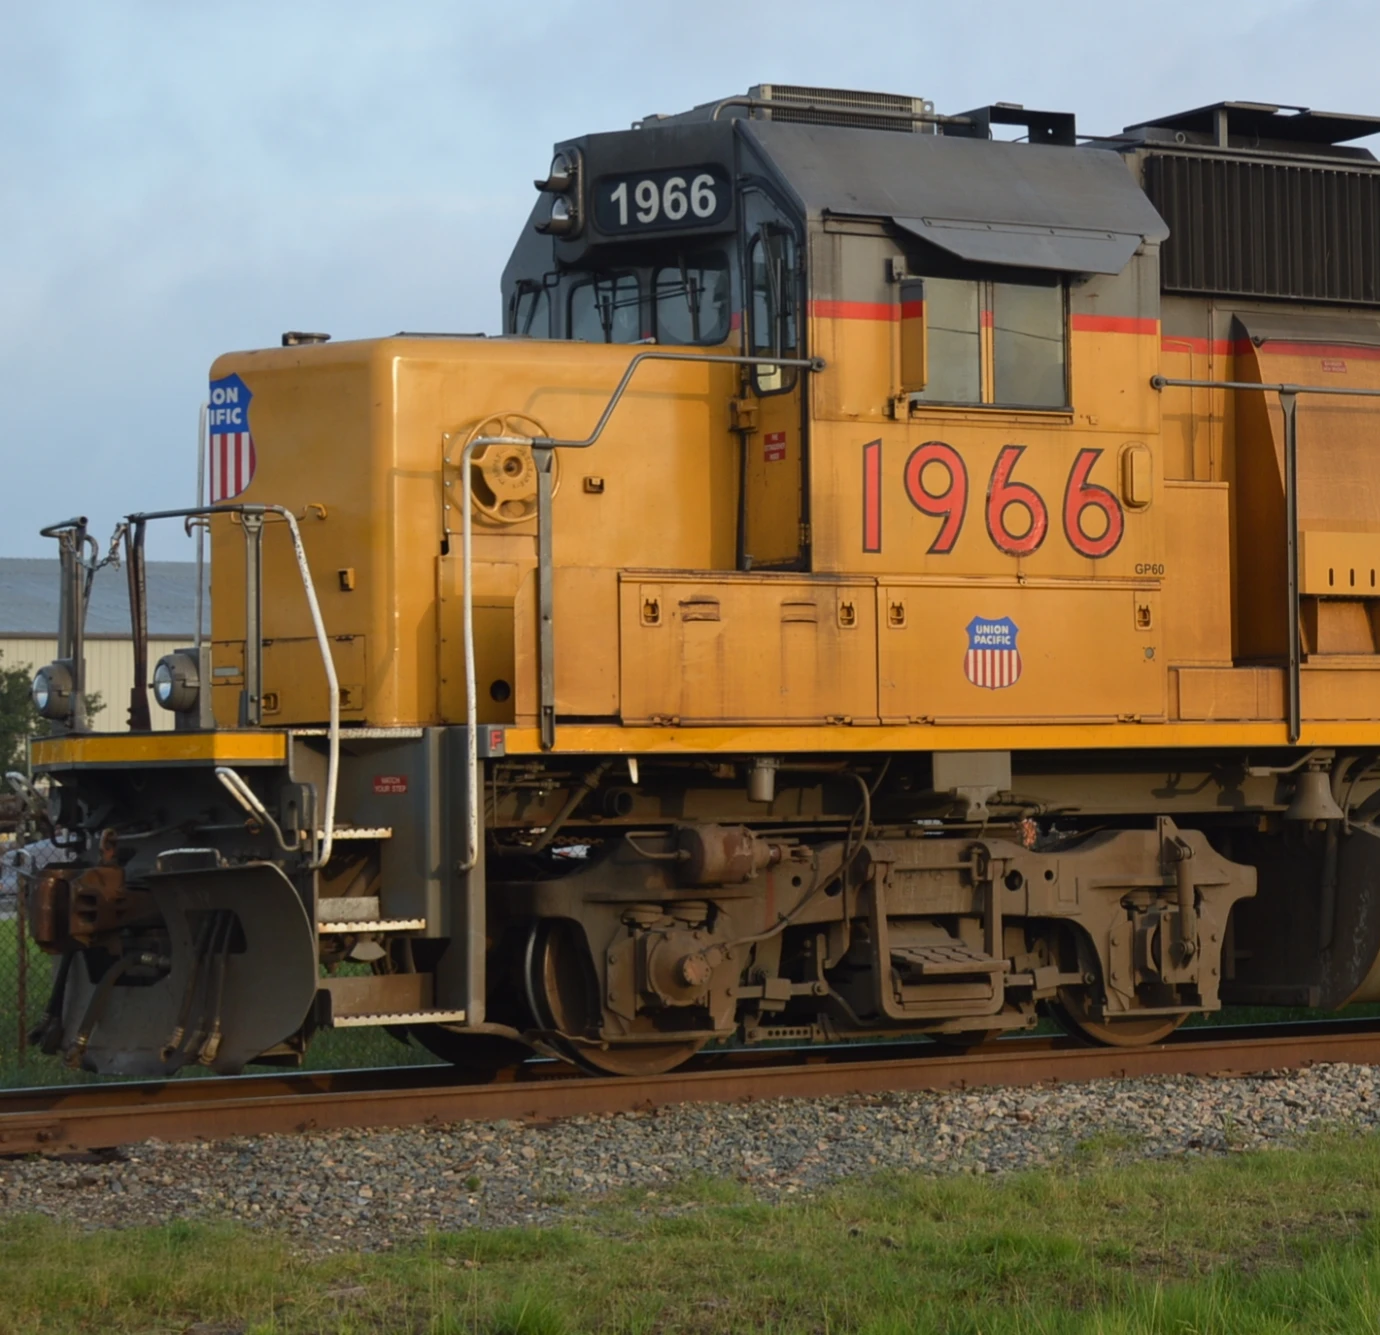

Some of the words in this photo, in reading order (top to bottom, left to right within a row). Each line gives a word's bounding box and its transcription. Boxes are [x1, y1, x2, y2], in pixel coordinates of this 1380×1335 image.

[610, 173, 717, 226] 1966
[862, 437, 1125, 560] 1966
[1135, 563, 1165, 575] GP60
[976, 625, 1009, 634] UNION
[974, 635, 1011, 645] PACIFIC
[490, 730, 502, 750] F
